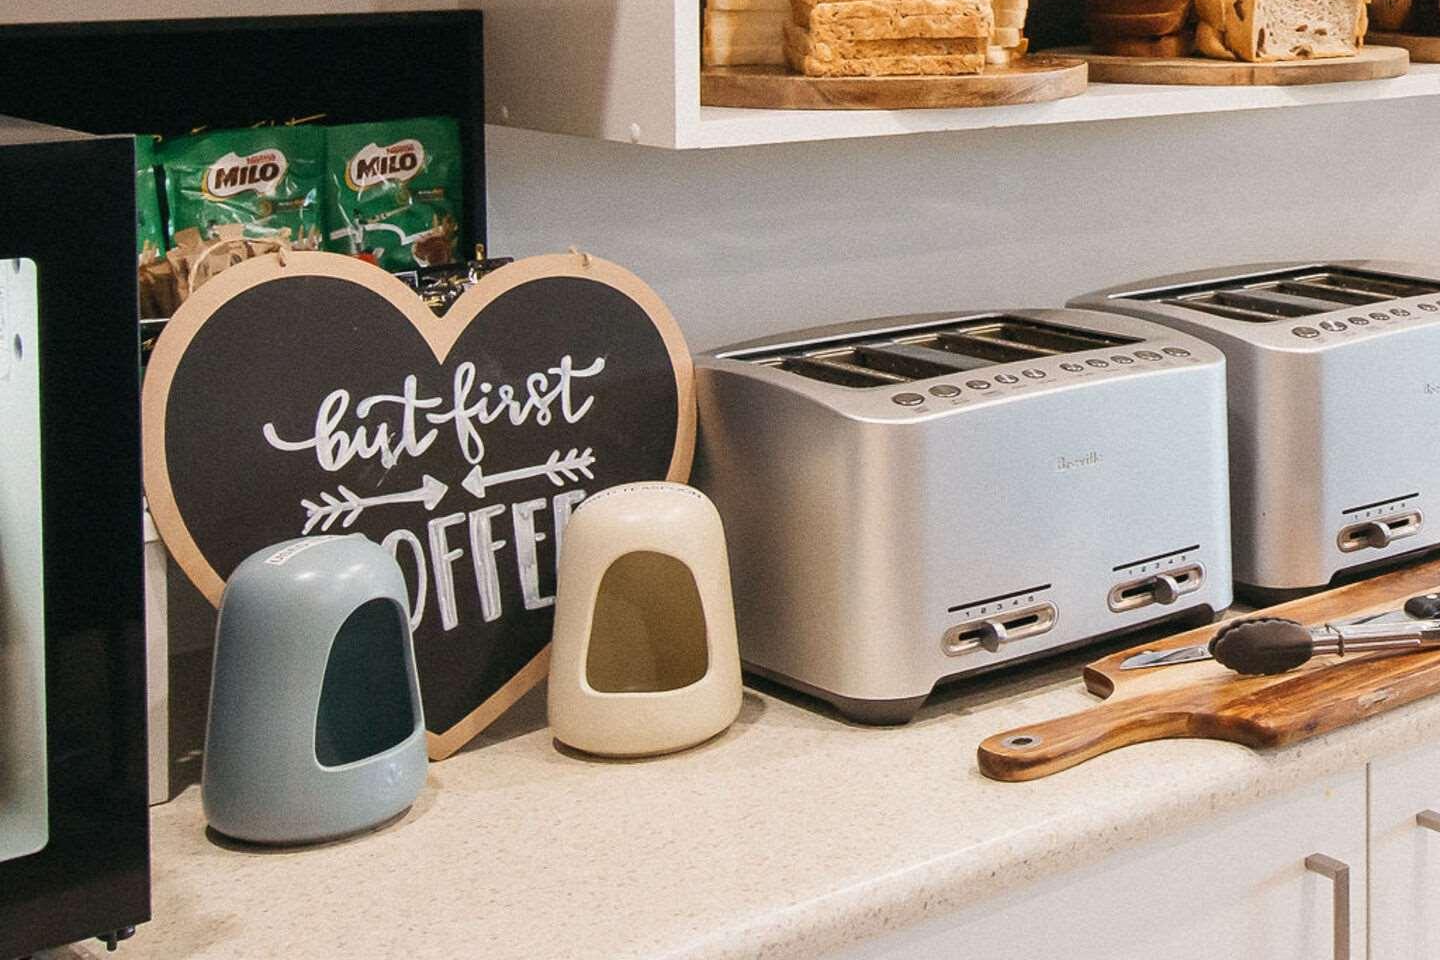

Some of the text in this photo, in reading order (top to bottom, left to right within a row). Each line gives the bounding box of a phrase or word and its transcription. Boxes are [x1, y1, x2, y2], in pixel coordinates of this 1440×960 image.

[215, 162, 280, 189] MILO
[357, 153, 417, 180] MILO
[262, 355, 606, 472] but first
[380, 489, 588, 633] OFFE
